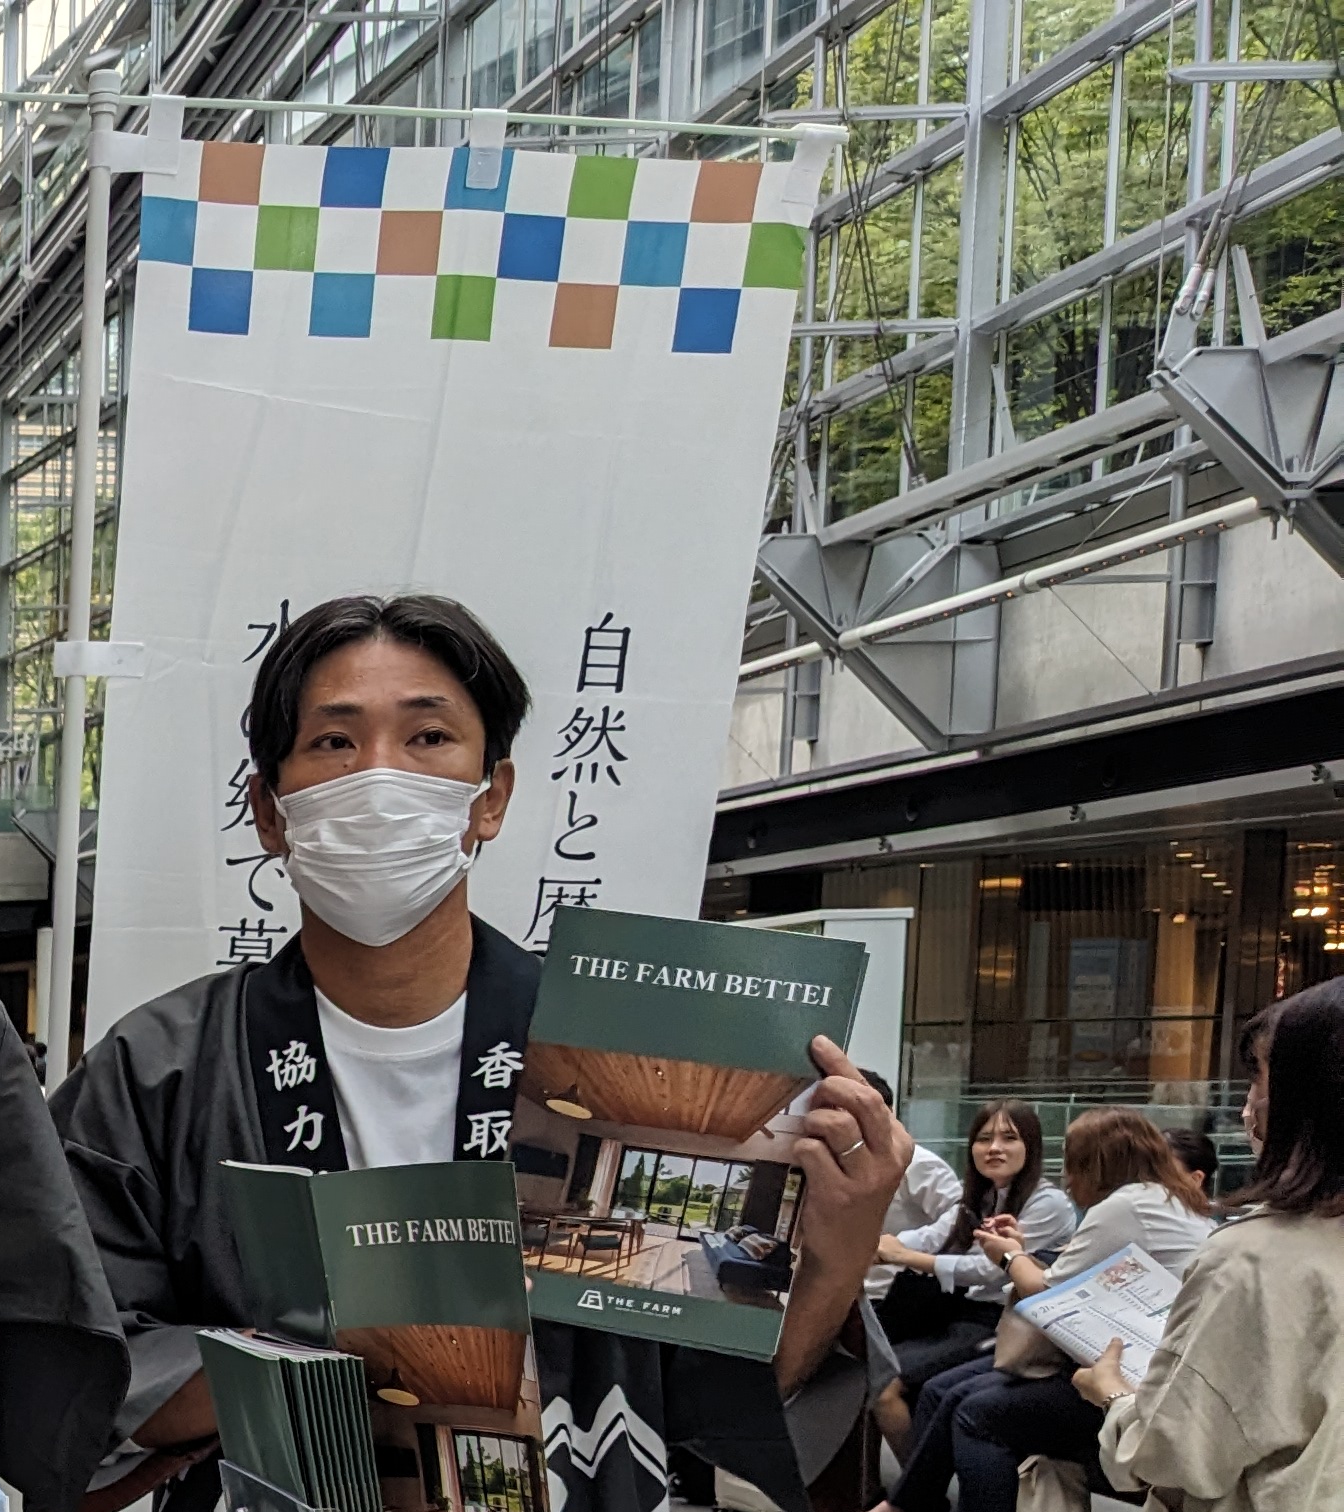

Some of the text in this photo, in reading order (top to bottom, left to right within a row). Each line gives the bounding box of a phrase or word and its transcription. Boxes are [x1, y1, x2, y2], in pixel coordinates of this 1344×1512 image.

[570, 954, 833, 1008] THE FARM BETTEI
[266, 1039, 326, 1152] 協力
[462, 1041, 524, 1159] 香取
[346, 1221, 402, 1247] THE
[406, 1218, 465, 1243] FARM
[607, 1295, 634, 1308] THE
[642, 1302, 683, 1316] FARM
